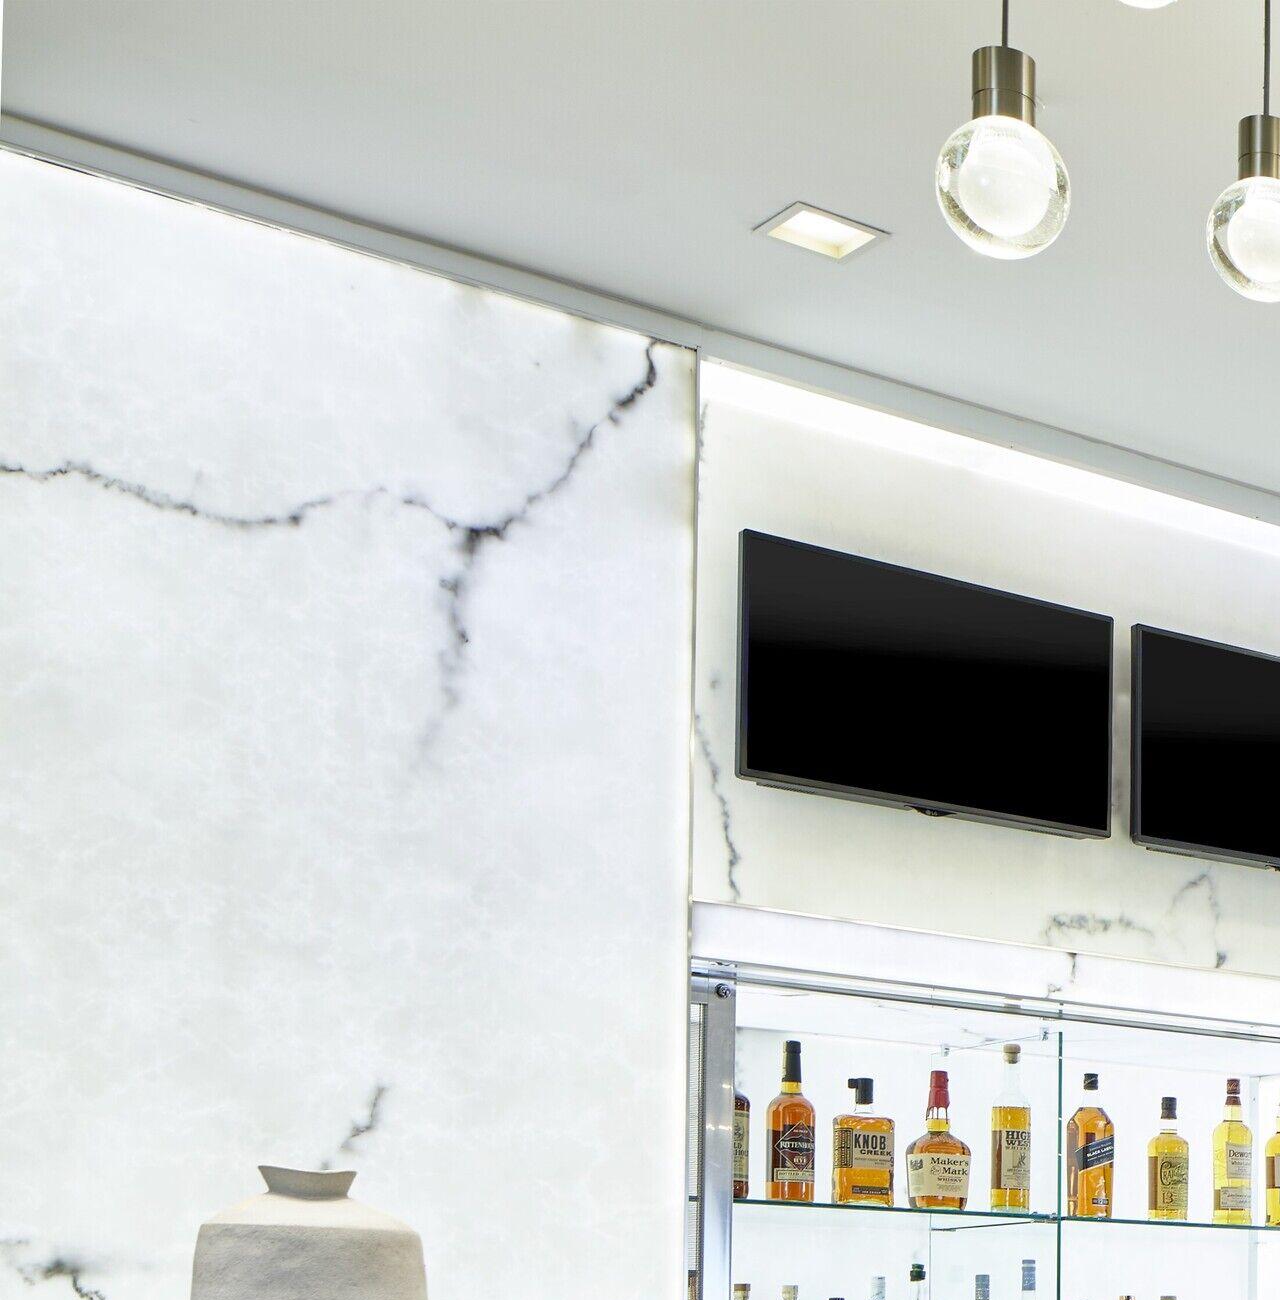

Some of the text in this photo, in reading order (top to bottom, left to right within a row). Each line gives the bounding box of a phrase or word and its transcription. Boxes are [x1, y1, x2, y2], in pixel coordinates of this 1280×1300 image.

[854, 1133, 887, 1150] KNOB
[860, 1149, 892, 1157] CREEK
[931, 1157, 969, 1167] Maker's
[942, 1167, 968, 1175] Mark
